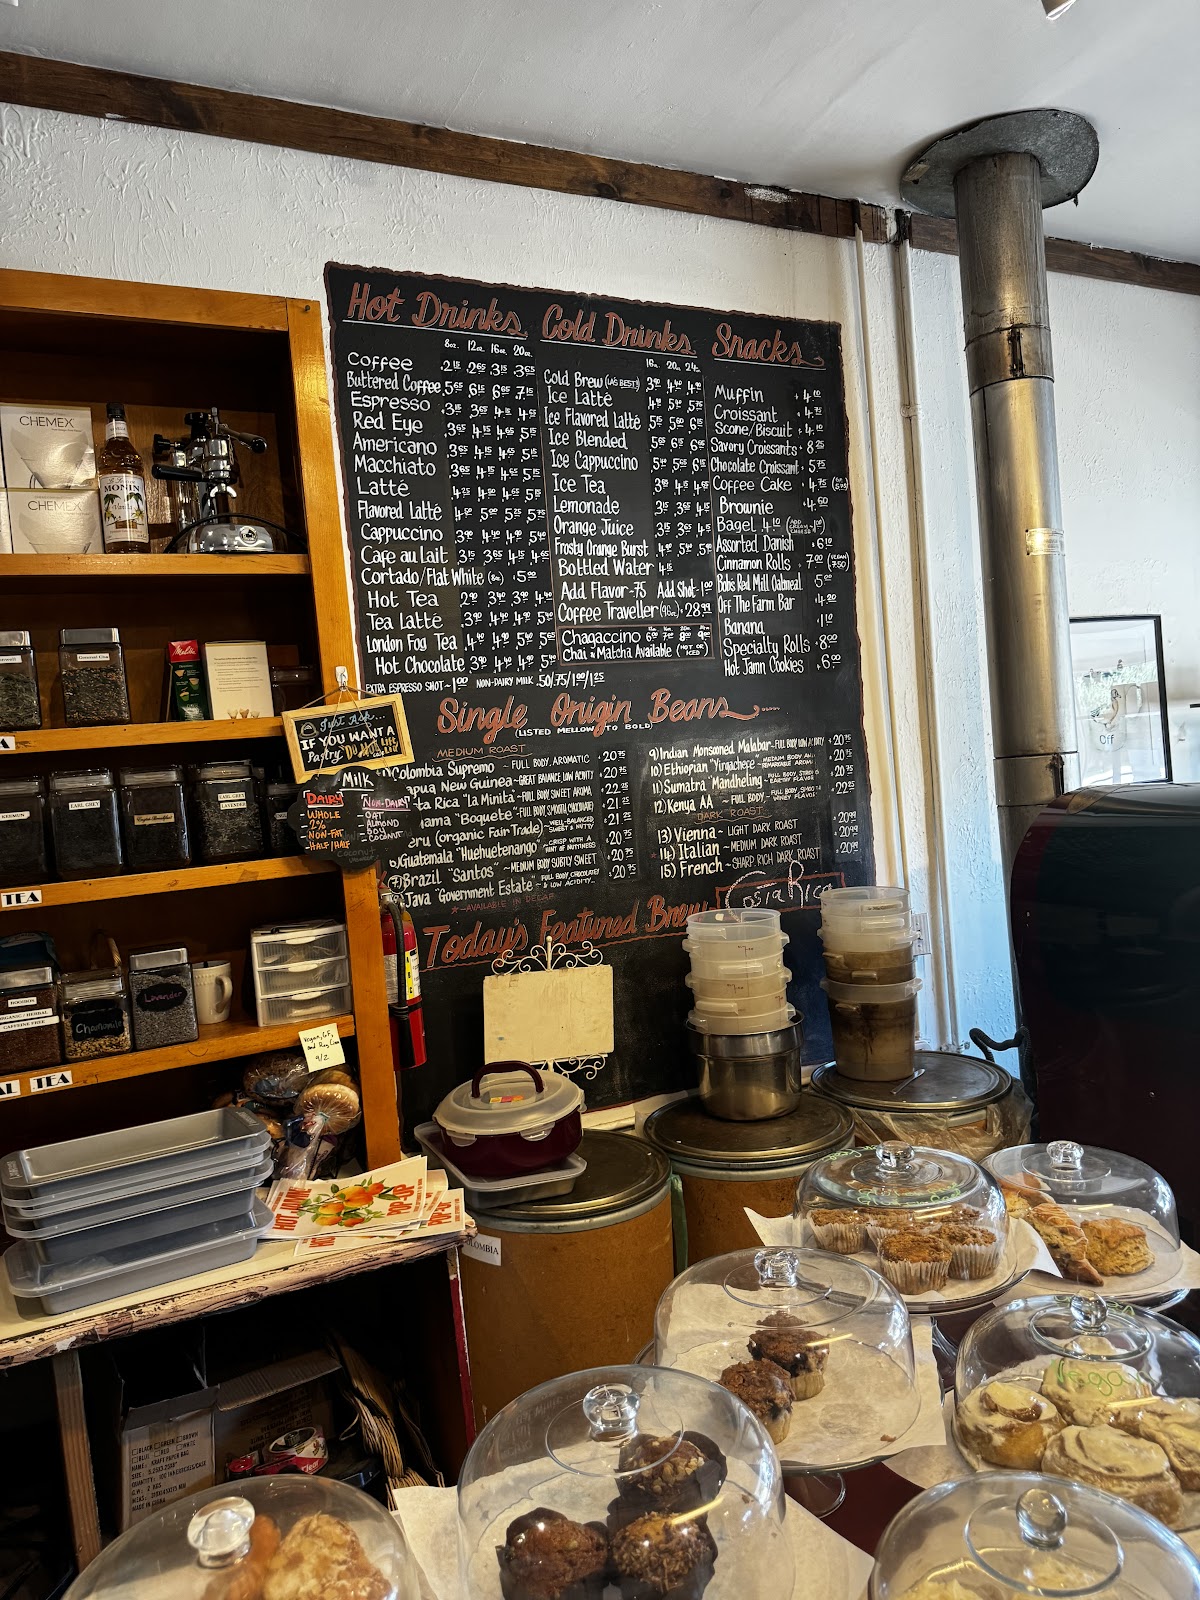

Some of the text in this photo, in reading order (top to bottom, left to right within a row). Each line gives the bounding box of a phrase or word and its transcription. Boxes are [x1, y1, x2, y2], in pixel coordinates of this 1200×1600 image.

[347, 282, 528, 337] Hot Drinks
[542, 304, 696, 355] Cold Drinks
[712, 322, 825, 367] Snacks
[348, 352, 413, 371] Coffee
[347, 372, 441, 396] Buttered Coffee
[544, 369, 604, 389] Cold Brew
[351, 390, 430, 412] Espresso
[714, 384, 764, 404] Muffin
[20, 415, 74, 428] CHEMEX
[565, 408, 609, 428] Flavored
[714, 404, 778, 424] Croissant
[353, 412, 423, 436] Red Eye
[715, 421, 792, 438] Scone/Biscuit
[353, 432, 437, 456] Americano
[576, 430, 628, 450] Blended
[711, 437, 798, 456] Savory Croissants
[354, 455, 436, 476] Macchiato
[575, 451, 638, 472] Cappuccino
[711, 457, 800, 475] Chocolate Croissant
[104, 484, 140, 492] MONIN
[580, 475, 606, 494] Tea
[713, 476, 792, 493] Coffee Cake
[28, 500, 82, 512] CHEMEX
[358, 500, 402, 520] Flavored
[554, 495, 620, 514] Lemonade
[720, 496, 774, 515] Brownie
[361, 522, 443, 544] Cappuccino
[554, 514, 634, 537] Orange Juice
[717, 516, 756, 533] Bagel
[554, 537, 648, 558] Frosty Orange Burst
[716, 535, 794, 552] Assorted Danish
[420, 546, 449, 564] Lait
[717, 553, 790, 571] Cinnamon Rolls
[558, 558, 654, 576] Bottled Water
[560, 581, 587, 600] Add
[657, 581, 674, 598] Add
[737, 572, 803, 591] Red Mill Oatmeal
[367, 590, 439, 608] Hot Tea
[734, 594, 795, 613] The Farm Bar
[366, 613, 394, 630] Tea
[558, 600, 659, 624] Coffee Traveller
[724, 618, 764, 636] Banana
[366, 632, 457, 653] London Fog Tea
[562, 630, 640, 648] Chagaccino
[724, 634, 810, 659] Specialty Rolls
[563, 644, 672, 662] Chai Matcha Available
[375, 654, 465, 675] Hot Chocolate
[724, 655, 804, 676] Hot Cookies
[389, 682, 422, 692] ESPRESSO
[437, 688, 760, 744] Single Origin Beans
[300, 726, 396, 750] IF YOU WANT A
[557, 726, 594, 734] MELLOW
[308, 749, 344, 764] Pastry
[437, 744, 526, 758] MEDIUM ROAST
[693, 741, 735, 758] Monsooned
[448, 754, 590, 780] Supremo FULL AROMATIC
[342, 772, 374, 788] Milk
[441, 780, 467, 792] New
[434, 796, 460, 810] Rica
[700, 794, 714, 810] AA
[308, 811, 340, 819] WHOLE
[697, 806, 763, 820] DARK ROAST
[310, 820, 326, 830] 2%
[366, 820, 400, 828] ALMOND
[367, 828, 386, 836] SOY
[436, 818, 544, 848] (organic Fair Trade)
[674, 818, 798, 844] Vienna LIGHT DARK ROAST
[308, 829, 344, 840] NON-FAT
[368, 831, 404, 842] COCONUT
[678, 833, 802, 861] Italian MEDIUM DARK ROAST
[403, 870, 442, 888] Brazil
[574, 853, 597, 865] SWEET
[680, 846, 820, 878] French RICH DARK ROAST
[3, 892, 40, 906] TEA
[405, 882, 494, 908] Java "Government
[423, 898, 640, 968] Today's Featured
[76, 1020, 122, 1034] Chamomile
[34, 1074, 70, 1088] TEA
[272, 1214, 299, 1230] HOT
[386, 1184, 414, 1216] POP-UP
[466, 1238, 498, 1254] OLOMBIA
